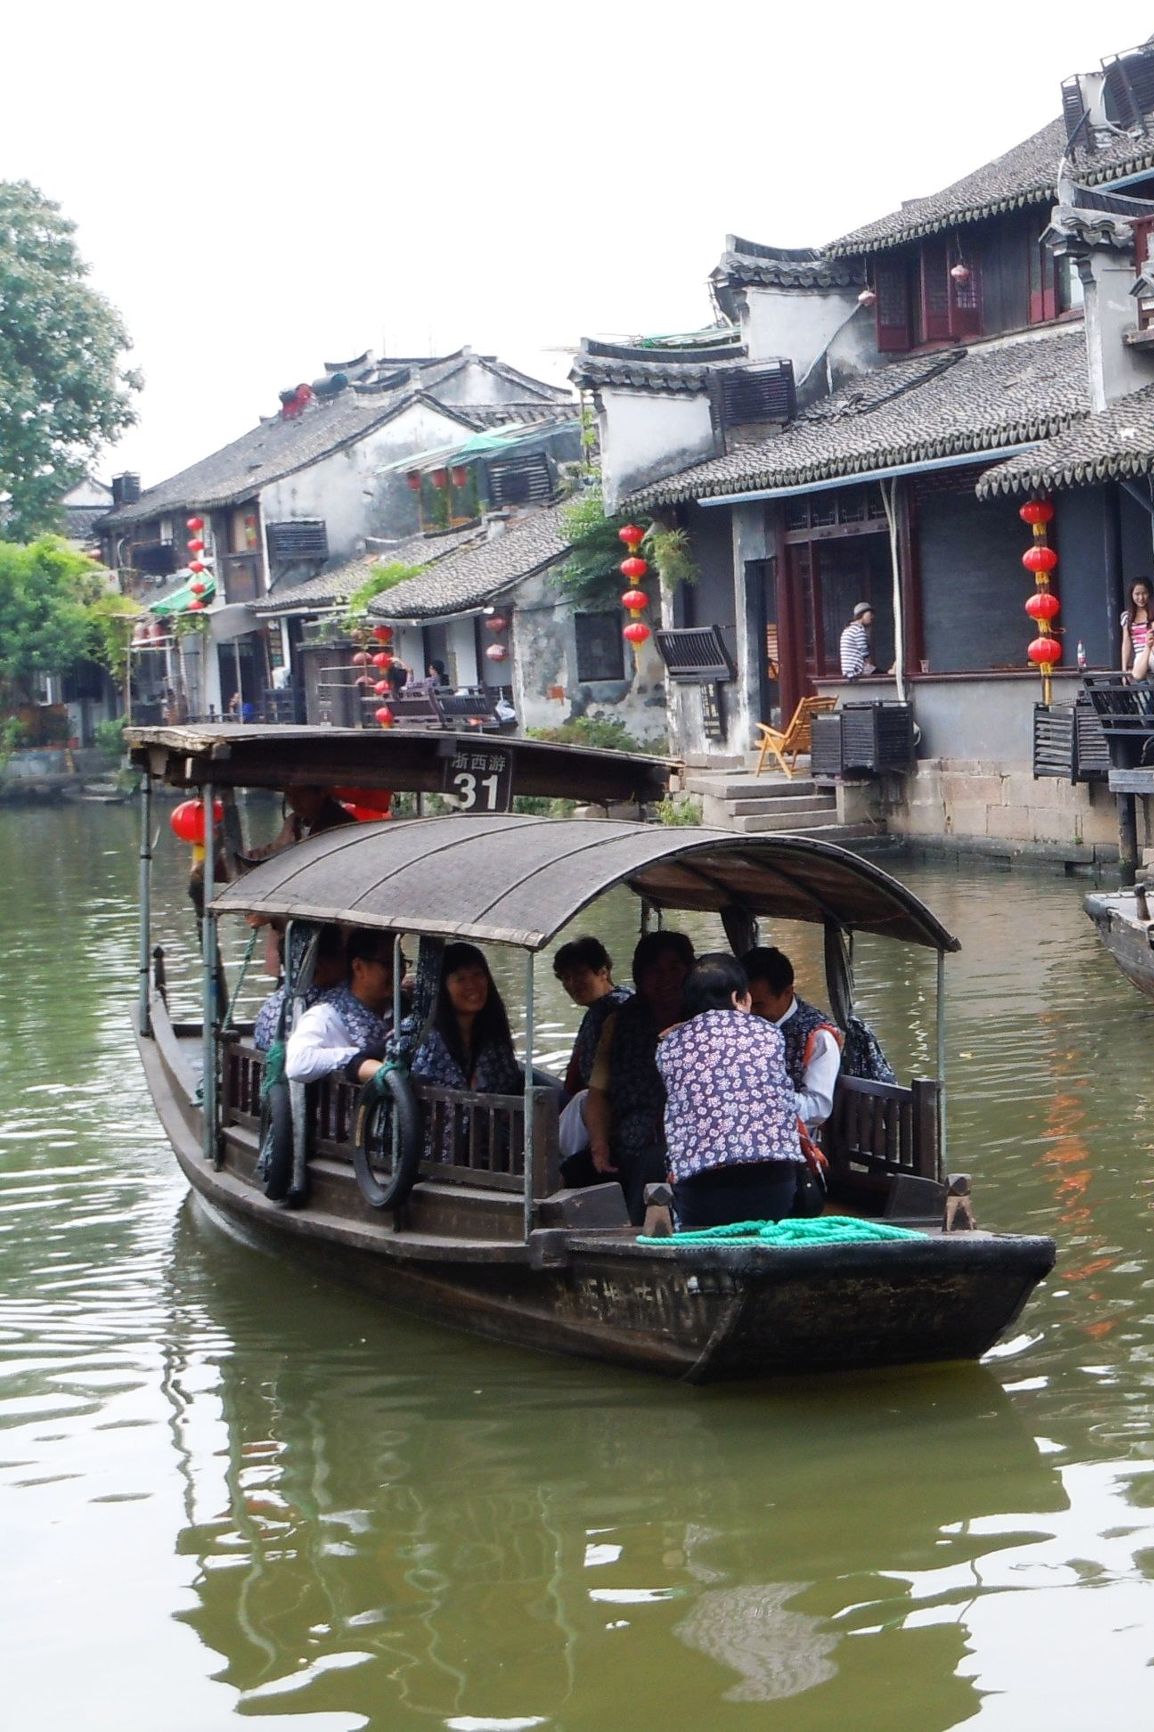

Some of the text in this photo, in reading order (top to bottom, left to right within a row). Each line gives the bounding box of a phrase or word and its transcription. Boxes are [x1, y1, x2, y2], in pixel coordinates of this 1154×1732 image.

[452, 752, 507, 772] 浙西游
[453, 772, 499, 811] 31
